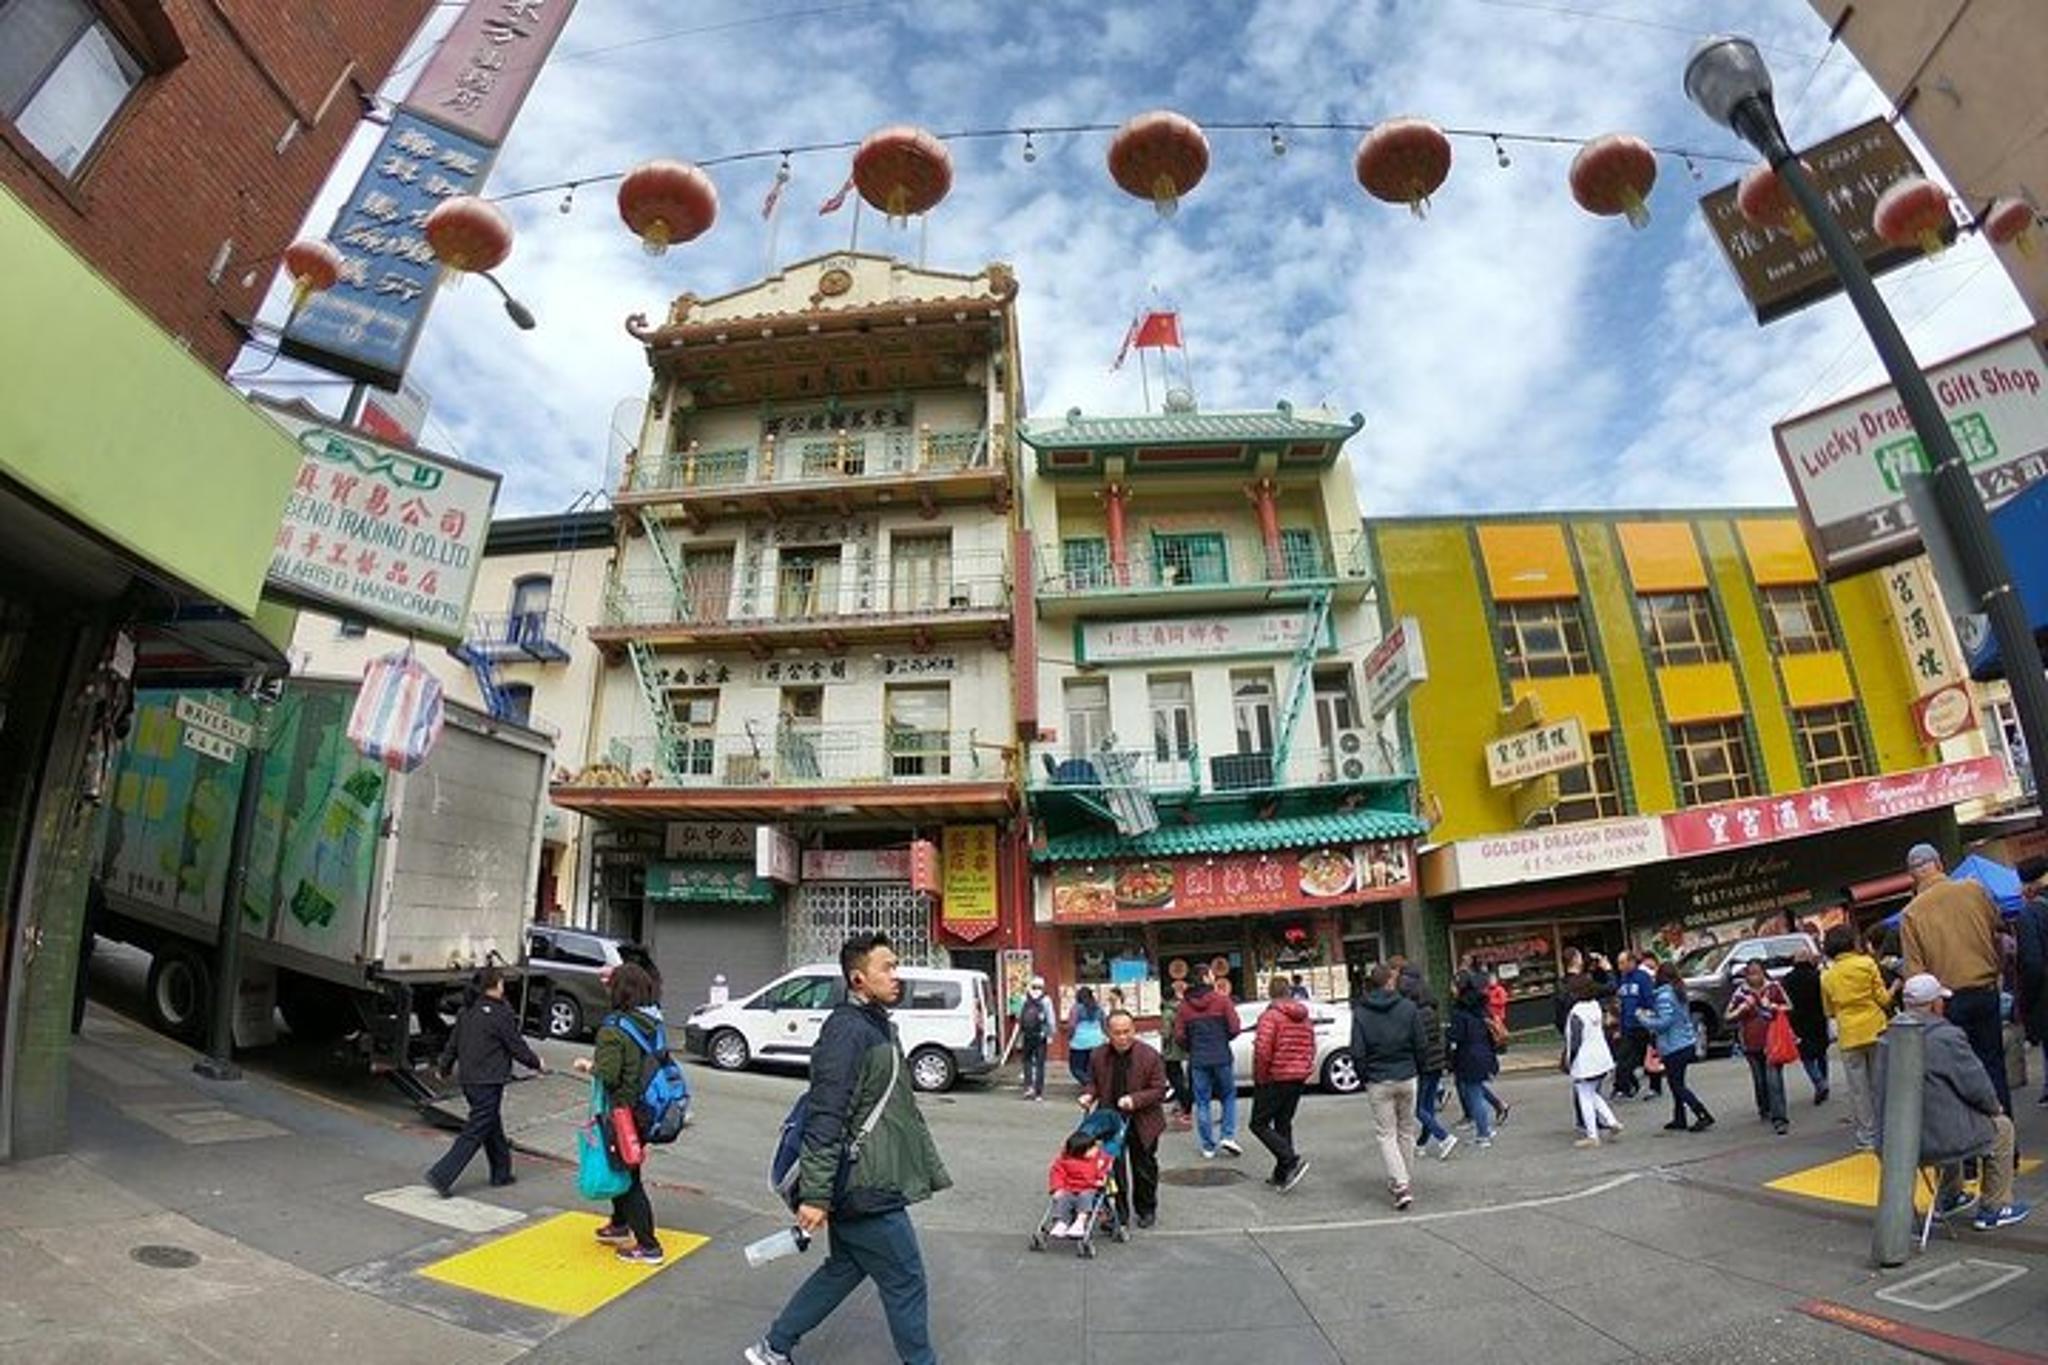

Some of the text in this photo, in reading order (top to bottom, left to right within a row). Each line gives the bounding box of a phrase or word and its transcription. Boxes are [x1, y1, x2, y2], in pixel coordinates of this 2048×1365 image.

[1801, 366, 2041, 478] Lucky Drag Gift Shop
[337, 510, 408, 550] TRADING
[184, 702, 248, 741] WAVERLY
[1705, 795, 1835, 844] 皇宮酒樓
[1481, 824, 1651, 858] GOLDEN DRAGON DINING
